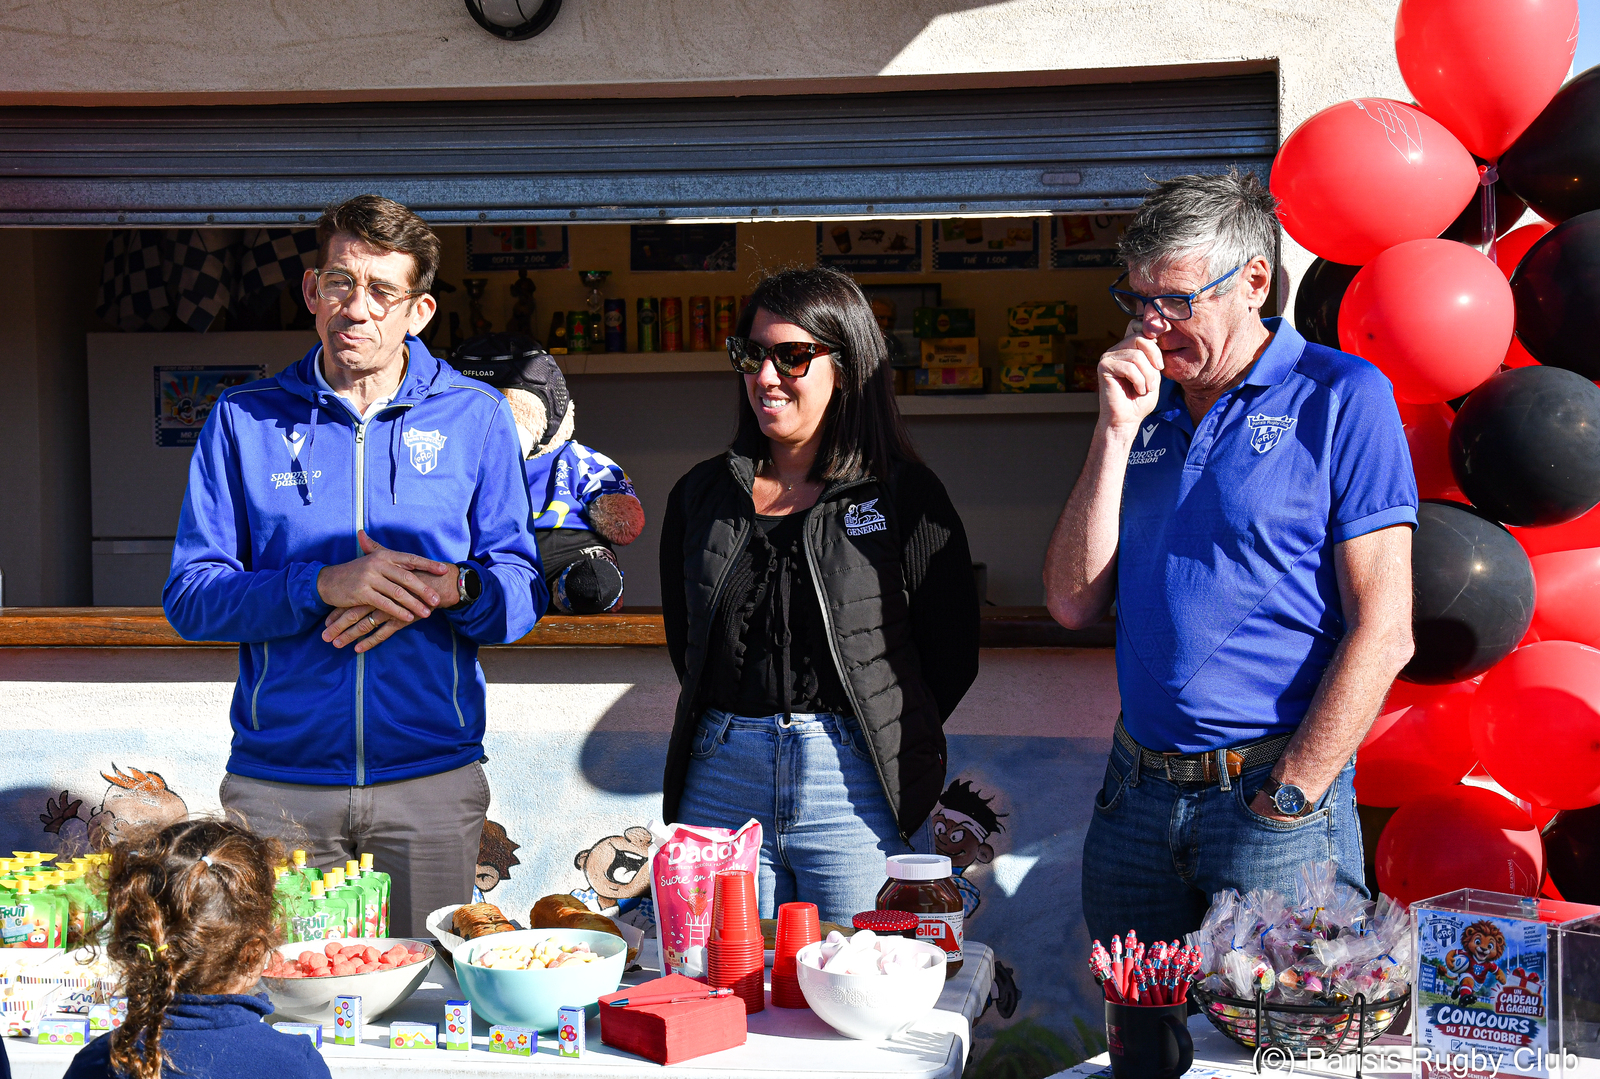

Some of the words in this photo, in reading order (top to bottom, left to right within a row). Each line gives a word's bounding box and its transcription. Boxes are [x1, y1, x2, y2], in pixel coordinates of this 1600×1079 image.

[846, 521, 888, 537] GENERALI
[668, 834, 748, 866] Daddy
[660, 875, 691, 887] Sucre
[915, 924, 940, 937] ella
[1500, 993, 1539, 1006] CADEAU
[1505, 1004, 1538, 1015] GAGNER
[1437, 1006, 1530, 1034] CONCOURS
[1446, 1025, 1456, 1034] DU
[1458, 1025, 1471, 1037] 17
[1472, 1028, 1523, 1045] OCTOBRE
